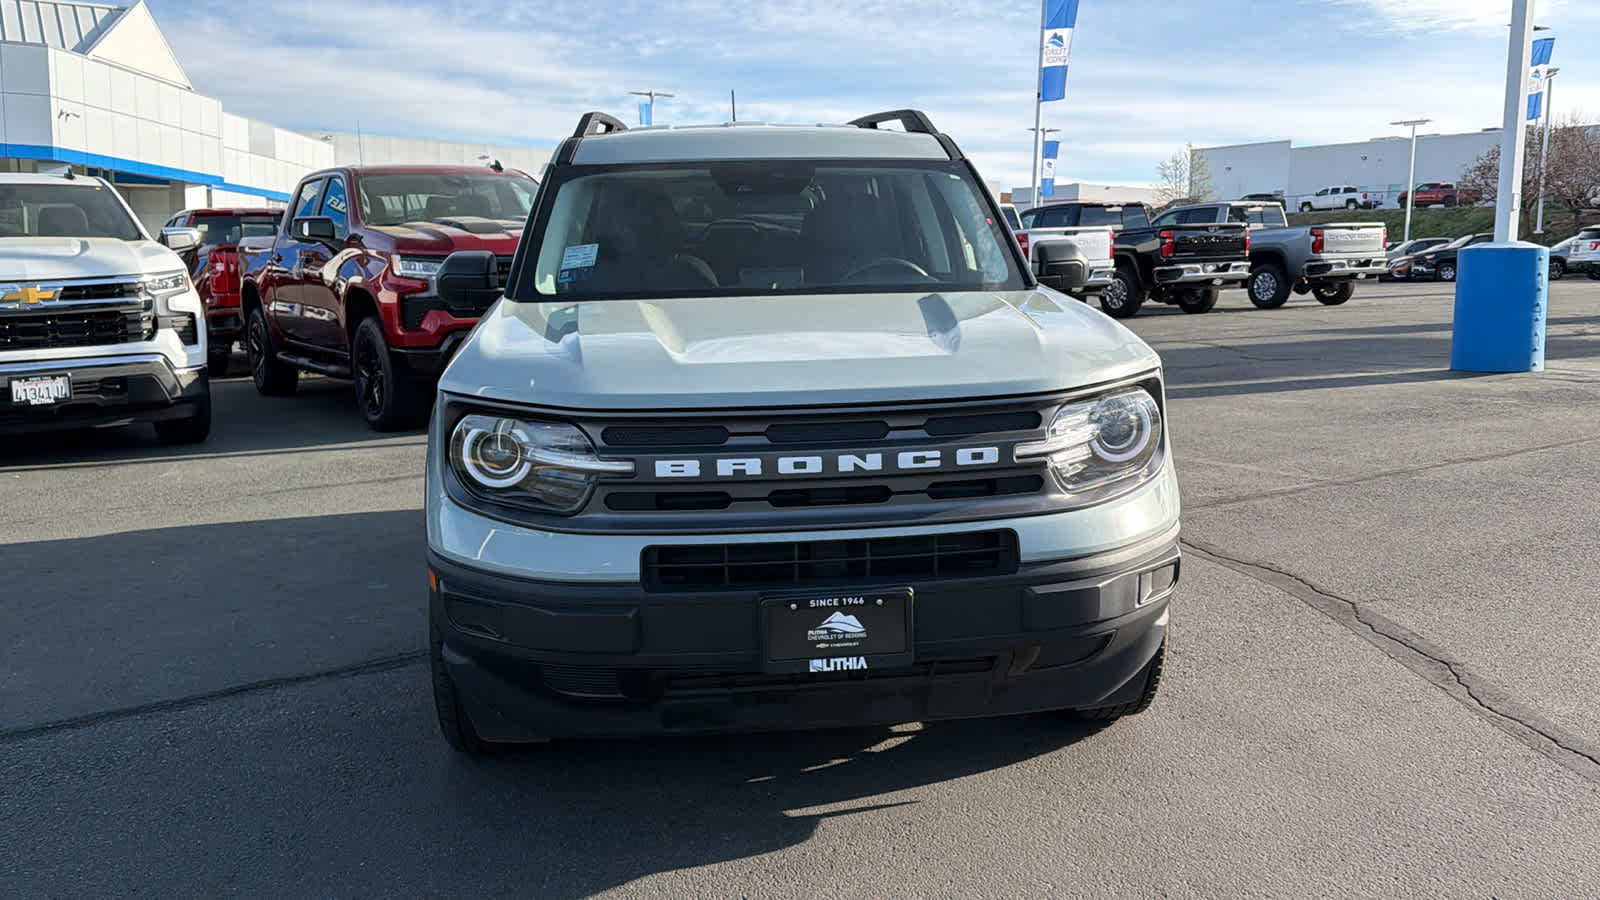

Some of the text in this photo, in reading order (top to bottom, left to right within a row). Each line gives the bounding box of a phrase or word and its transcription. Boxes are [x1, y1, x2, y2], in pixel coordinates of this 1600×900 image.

[655, 446, 999, 477] BRONCO
[809, 596, 864, 608] SINCE 1946
[822, 656, 868, 671] LITHIA
